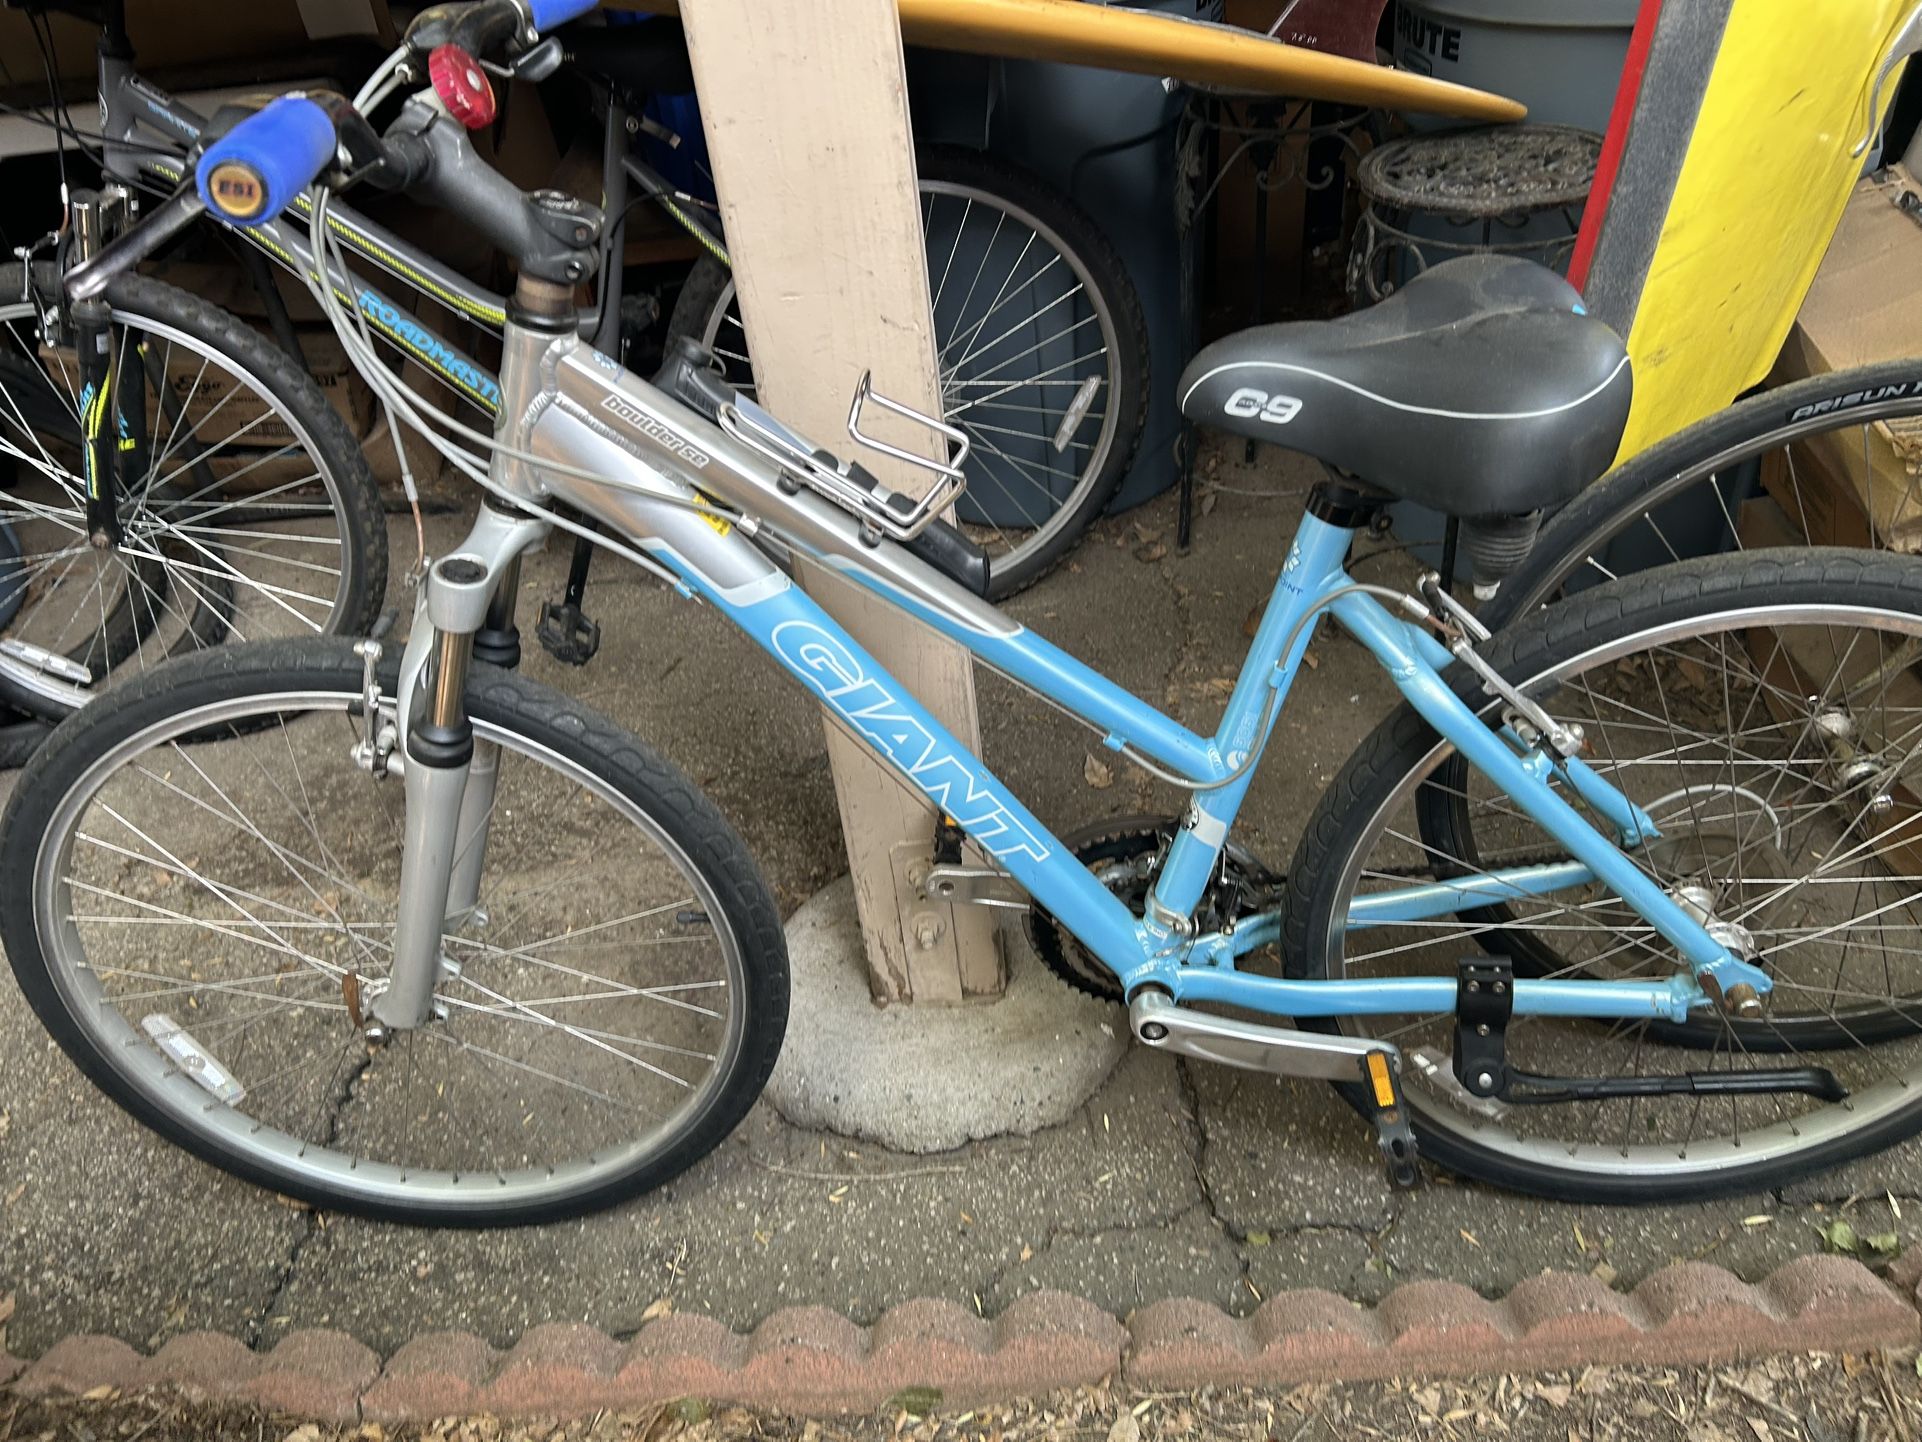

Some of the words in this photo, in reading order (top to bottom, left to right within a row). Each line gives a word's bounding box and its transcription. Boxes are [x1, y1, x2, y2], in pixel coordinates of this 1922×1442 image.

[1397, 4, 1462, 63] BRUTE
[600, 393, 684, 453] boulder
[677, 443, 710, 469] se
[1790, 383, 1907, 422] ARISUN
[771, 620, 1050, 863] GIANT
